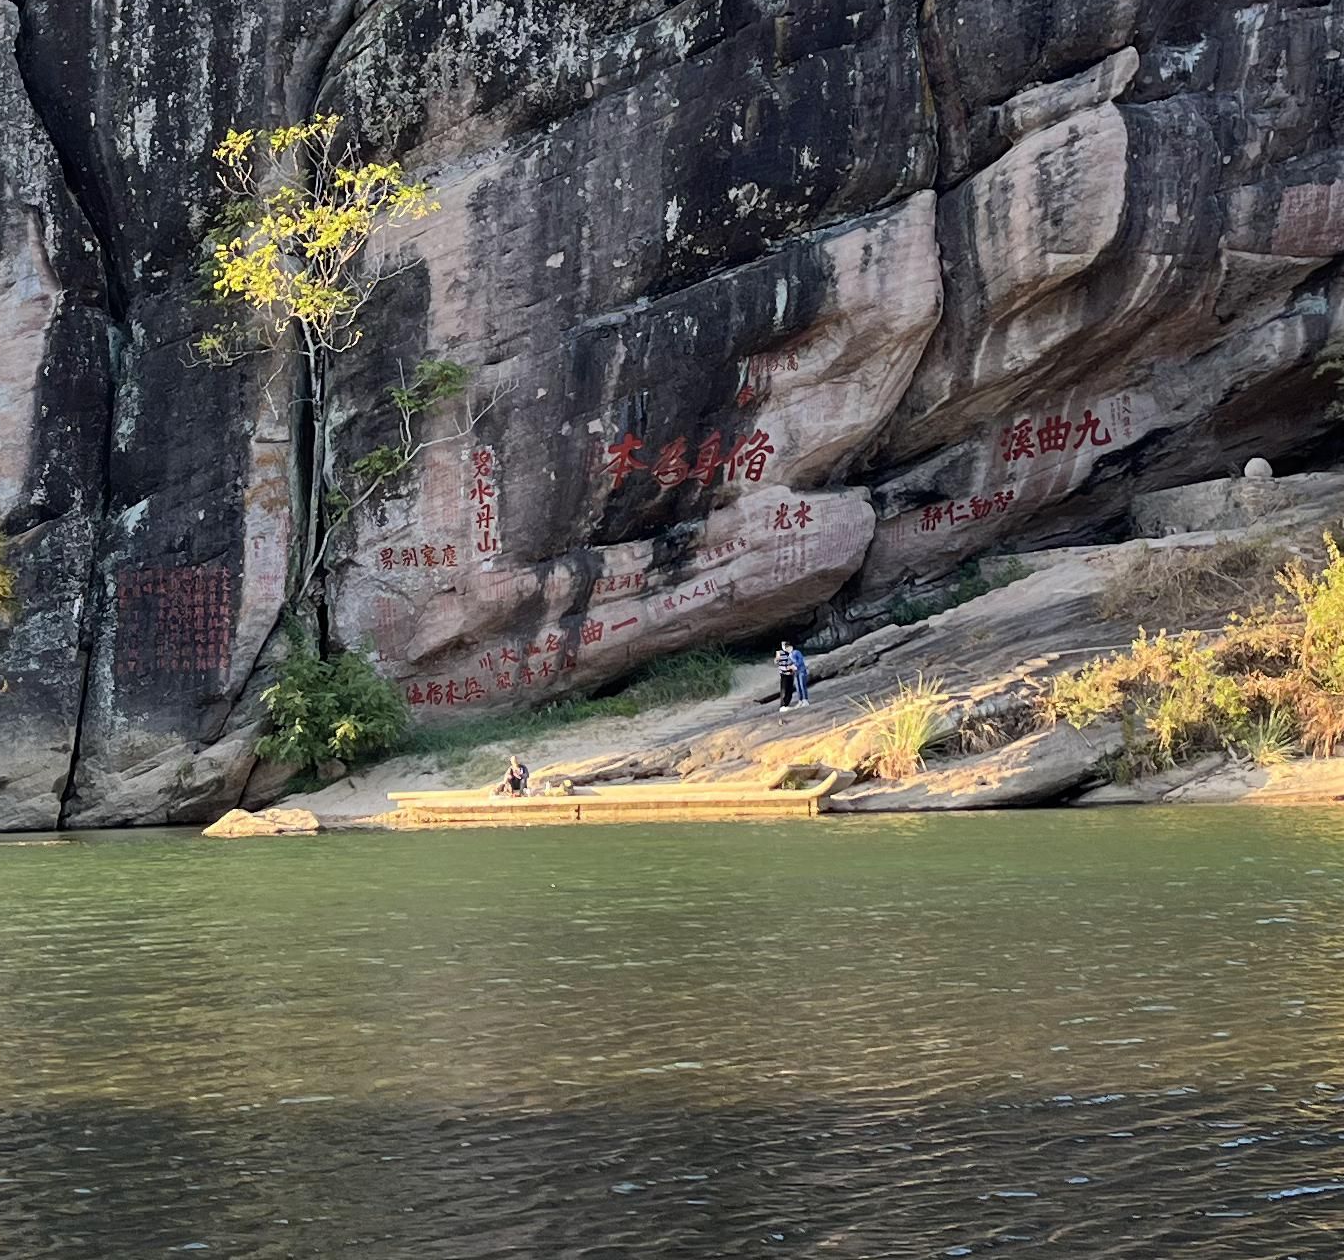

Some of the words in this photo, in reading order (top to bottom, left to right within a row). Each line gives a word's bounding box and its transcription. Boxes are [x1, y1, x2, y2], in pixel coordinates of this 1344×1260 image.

[1000, 409, 1112, 462] 九曲溪
[772, 500, 814, 531] 水光
[580, 616, 638, 646] 一曲
[478, 632, 562, 672] 名山大川
